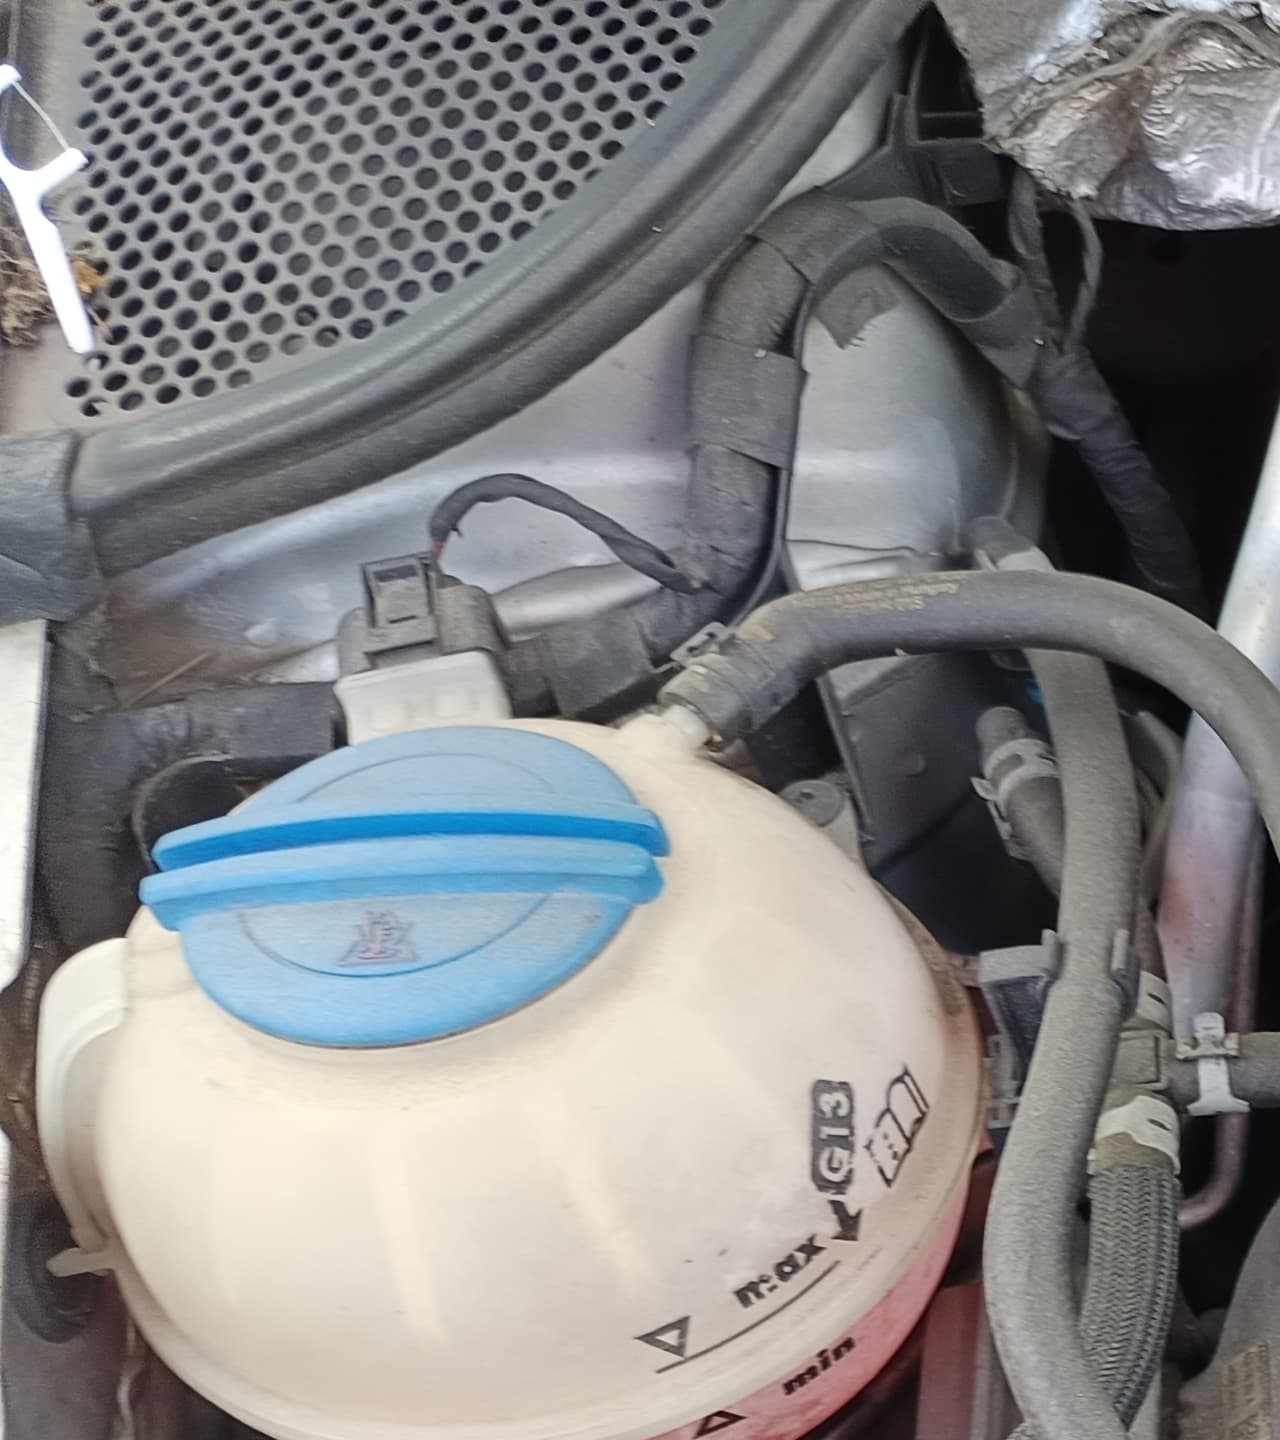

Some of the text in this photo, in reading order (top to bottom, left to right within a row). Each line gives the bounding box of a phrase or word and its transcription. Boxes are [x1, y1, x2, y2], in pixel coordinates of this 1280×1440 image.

[815, 1085, 853, 1189] G13
[733, 1234, 827, 1308] max
[782, 1337, 856, 1396] min
